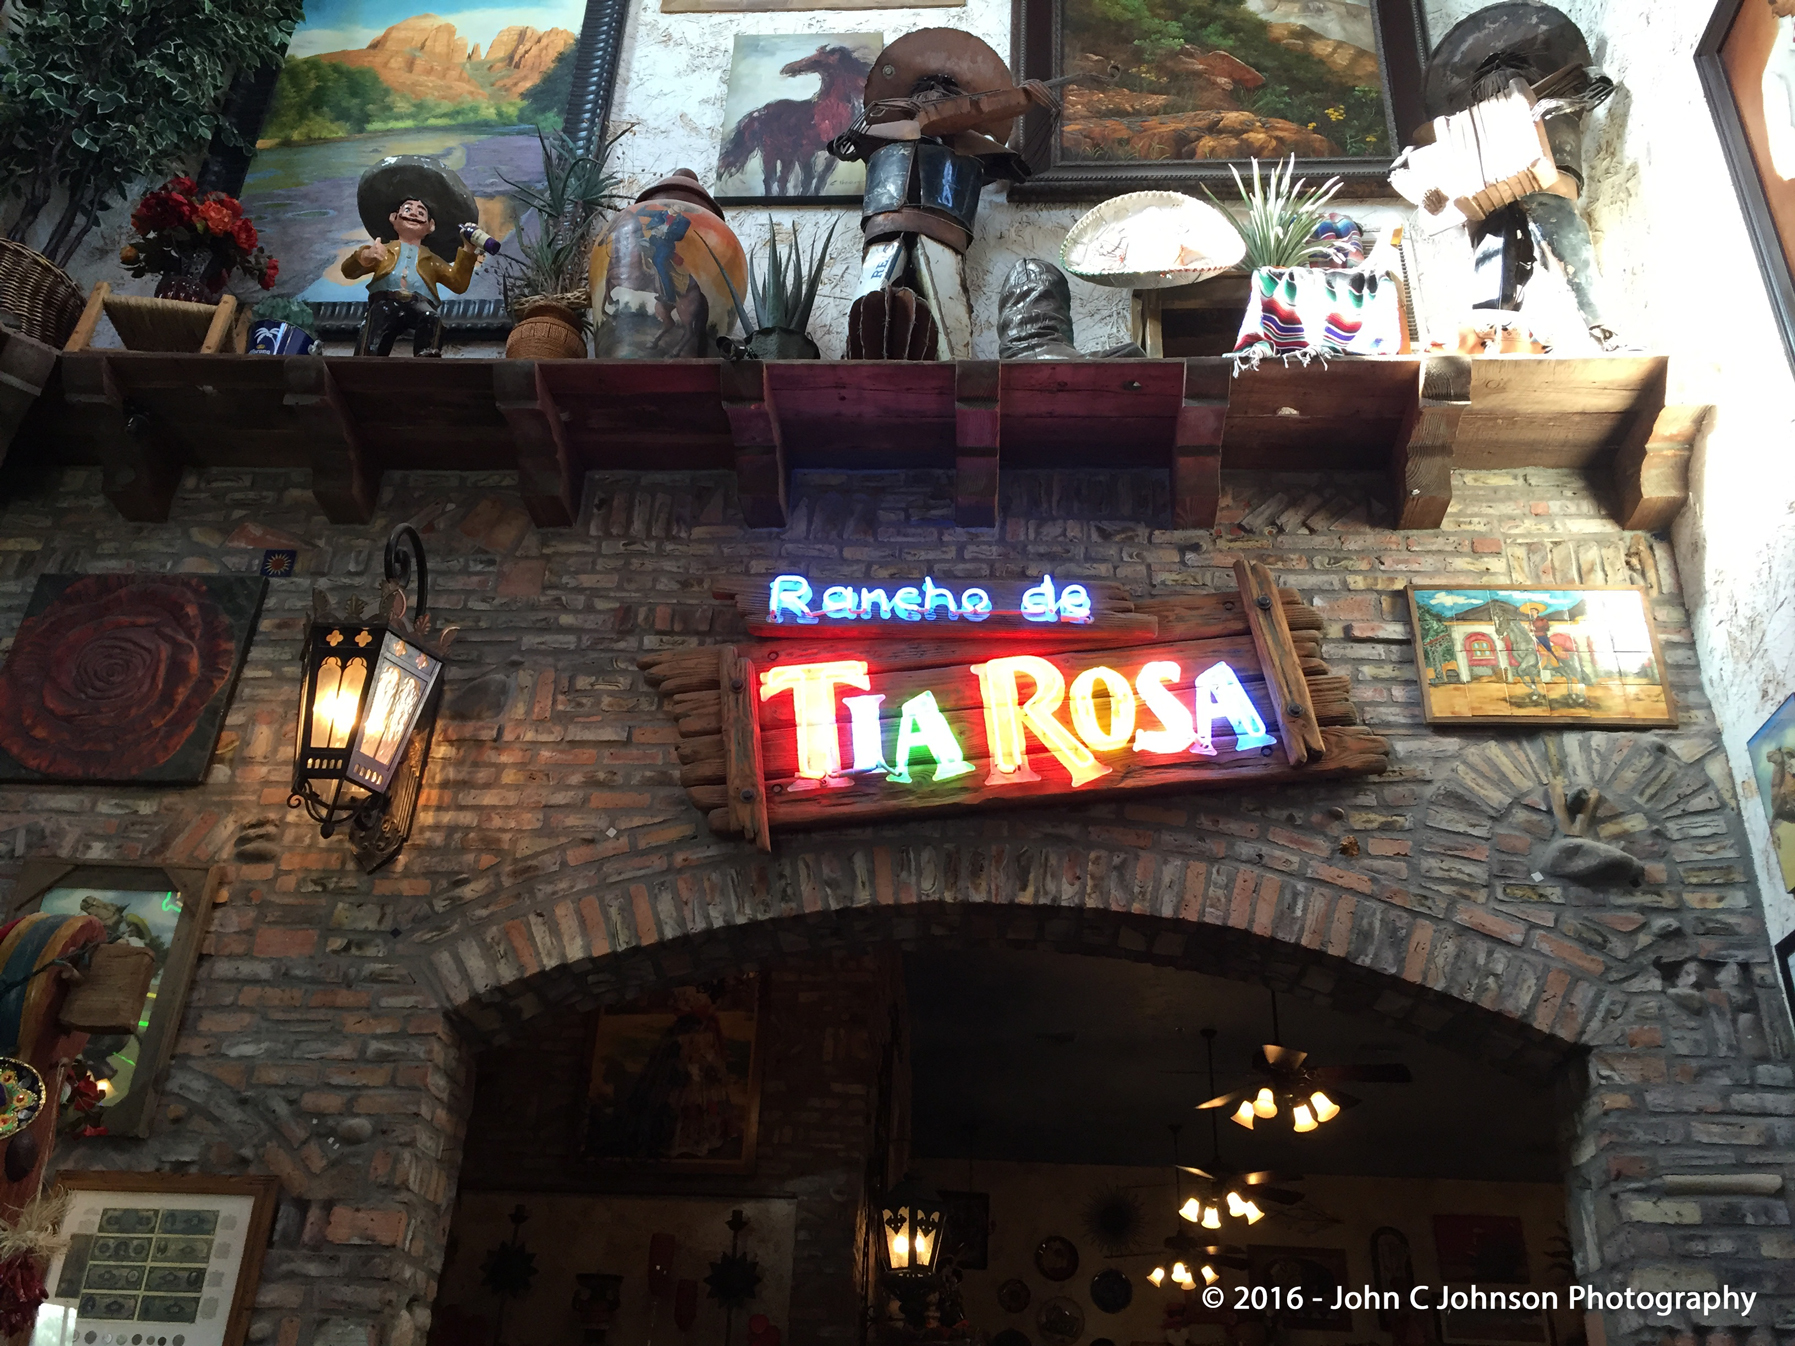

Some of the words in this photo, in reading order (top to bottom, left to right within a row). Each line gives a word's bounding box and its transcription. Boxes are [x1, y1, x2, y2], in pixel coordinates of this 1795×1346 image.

[766, 574, 992, 623] Rancho
[1021, 573, 1094, 624] de
[970, 655, 1277, 788] ROSA
